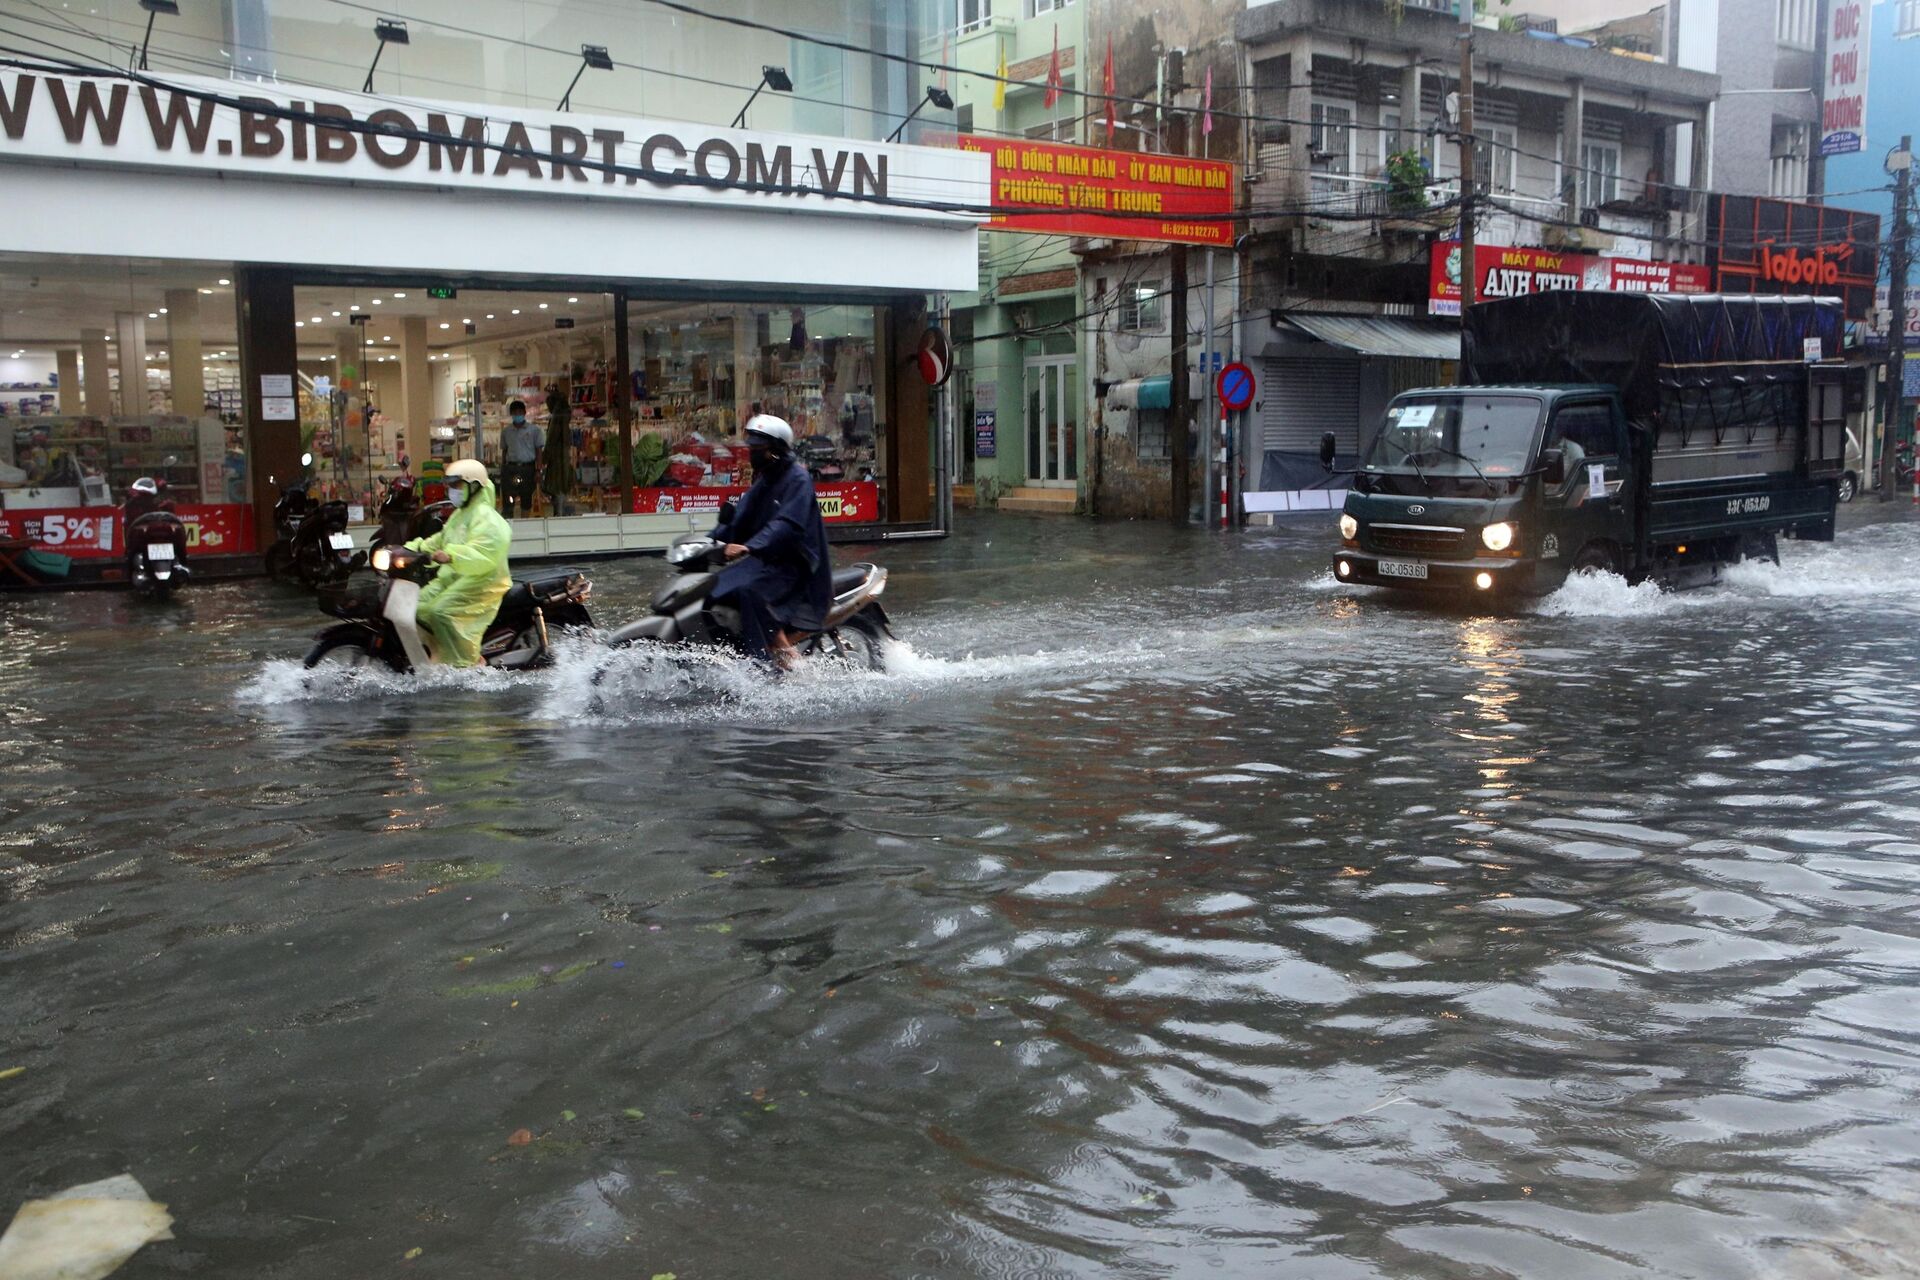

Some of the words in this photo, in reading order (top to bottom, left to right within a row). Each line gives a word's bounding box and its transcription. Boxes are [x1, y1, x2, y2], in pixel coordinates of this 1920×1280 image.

[1831, 43, 1858, 86] PHÚ
[996, 145, 1017, 173] HỘI
[1022, 146, 1053, 173] ĐỒNG
[1057, 154, 1089, 177] NHÂN
[1092, 156, 1116, 179] DÂN
[1130, 157, 1146, 181] ỦY
[1149, 164, 1172, 184] BAN
[1174, 165, 1203, 188] NHÂN
[1205, 167, 1226, 189] DÂN
[998, 176, 1064, 206] PHƯỜNG
[1068, 181, 1107, 209] VĨNH
[1111, 188, 1162, 213] TRUNG
[1502, 250, 1530, 267] MÁY
[1535, 256, 1563, 270] MAY
[1483, 267, 1533, 298] ANH
[1408, 505, 1424, 514] KIA
[43, 515, 94, 545] 5%
[1380, 564, 1427, 578] 43C-053.60
